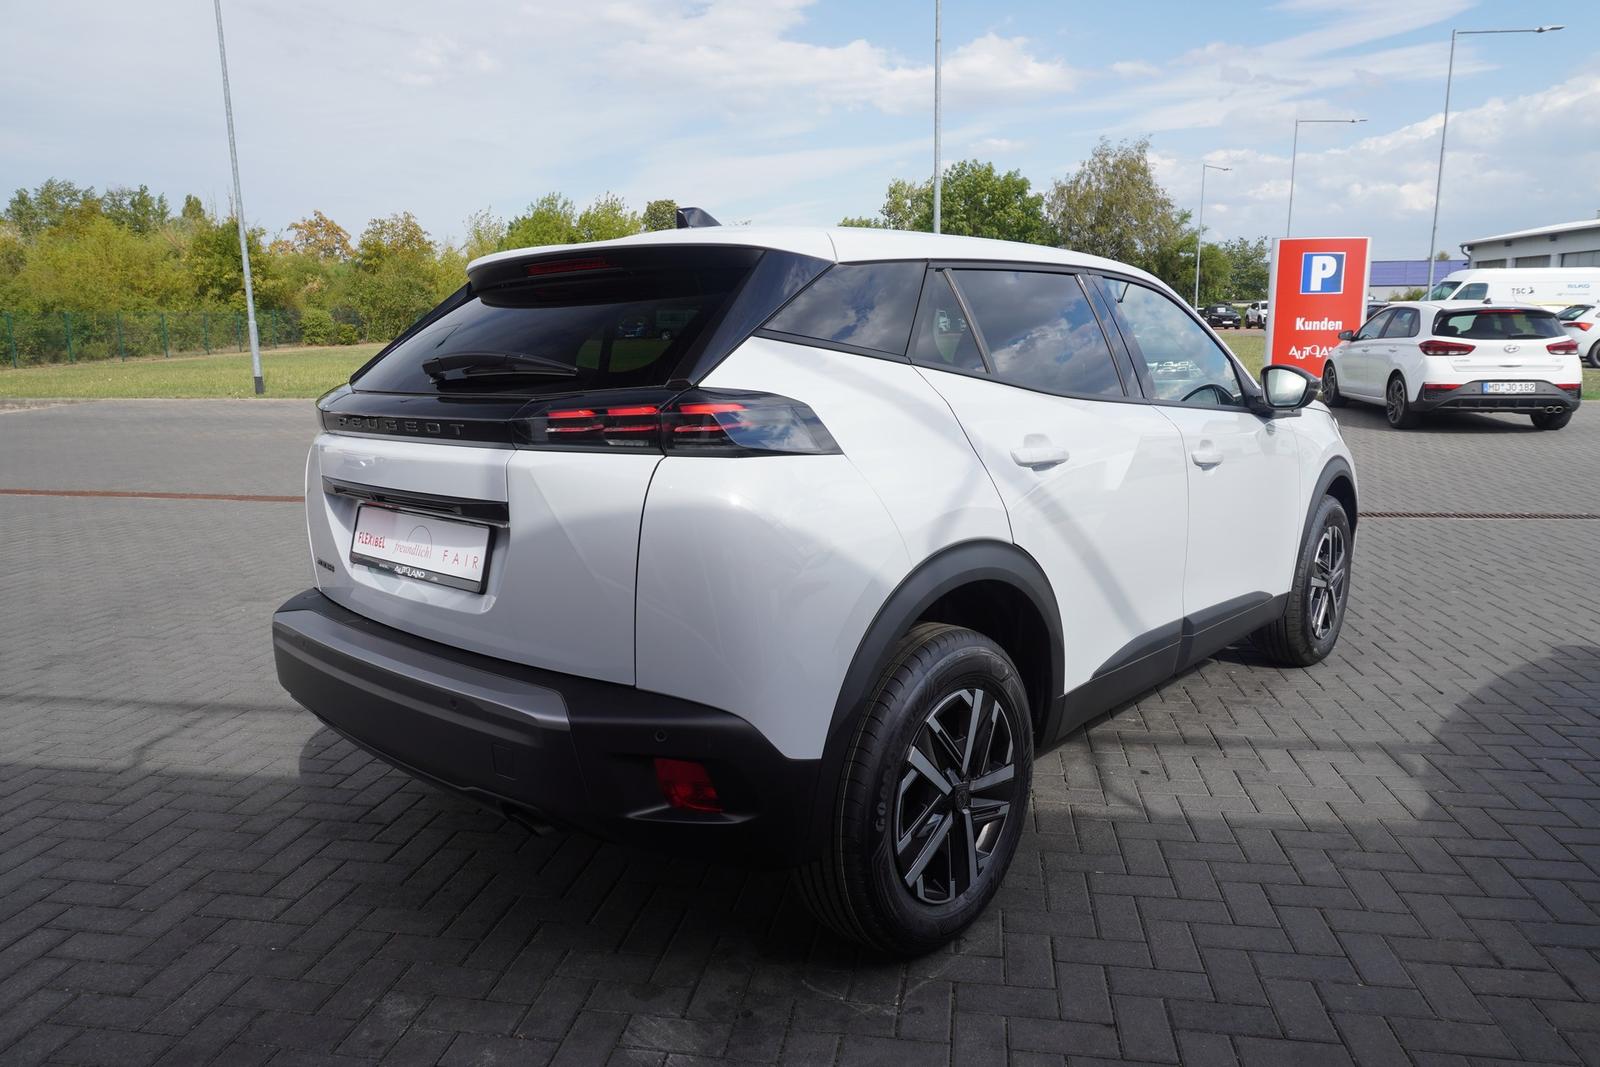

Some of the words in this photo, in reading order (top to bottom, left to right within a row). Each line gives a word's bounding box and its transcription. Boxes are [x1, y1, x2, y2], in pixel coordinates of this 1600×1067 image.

[1310, 255, 1337, 291] P
[1295, 317, 1343, 331] Kunden
[1519, 383, 1535, 392] 182
[337, 417, 465, 436] PEUGEOT
[357, 531, 386, 549] FLEXIBEL
[394, 565, 426, 579] AUTOLAND
